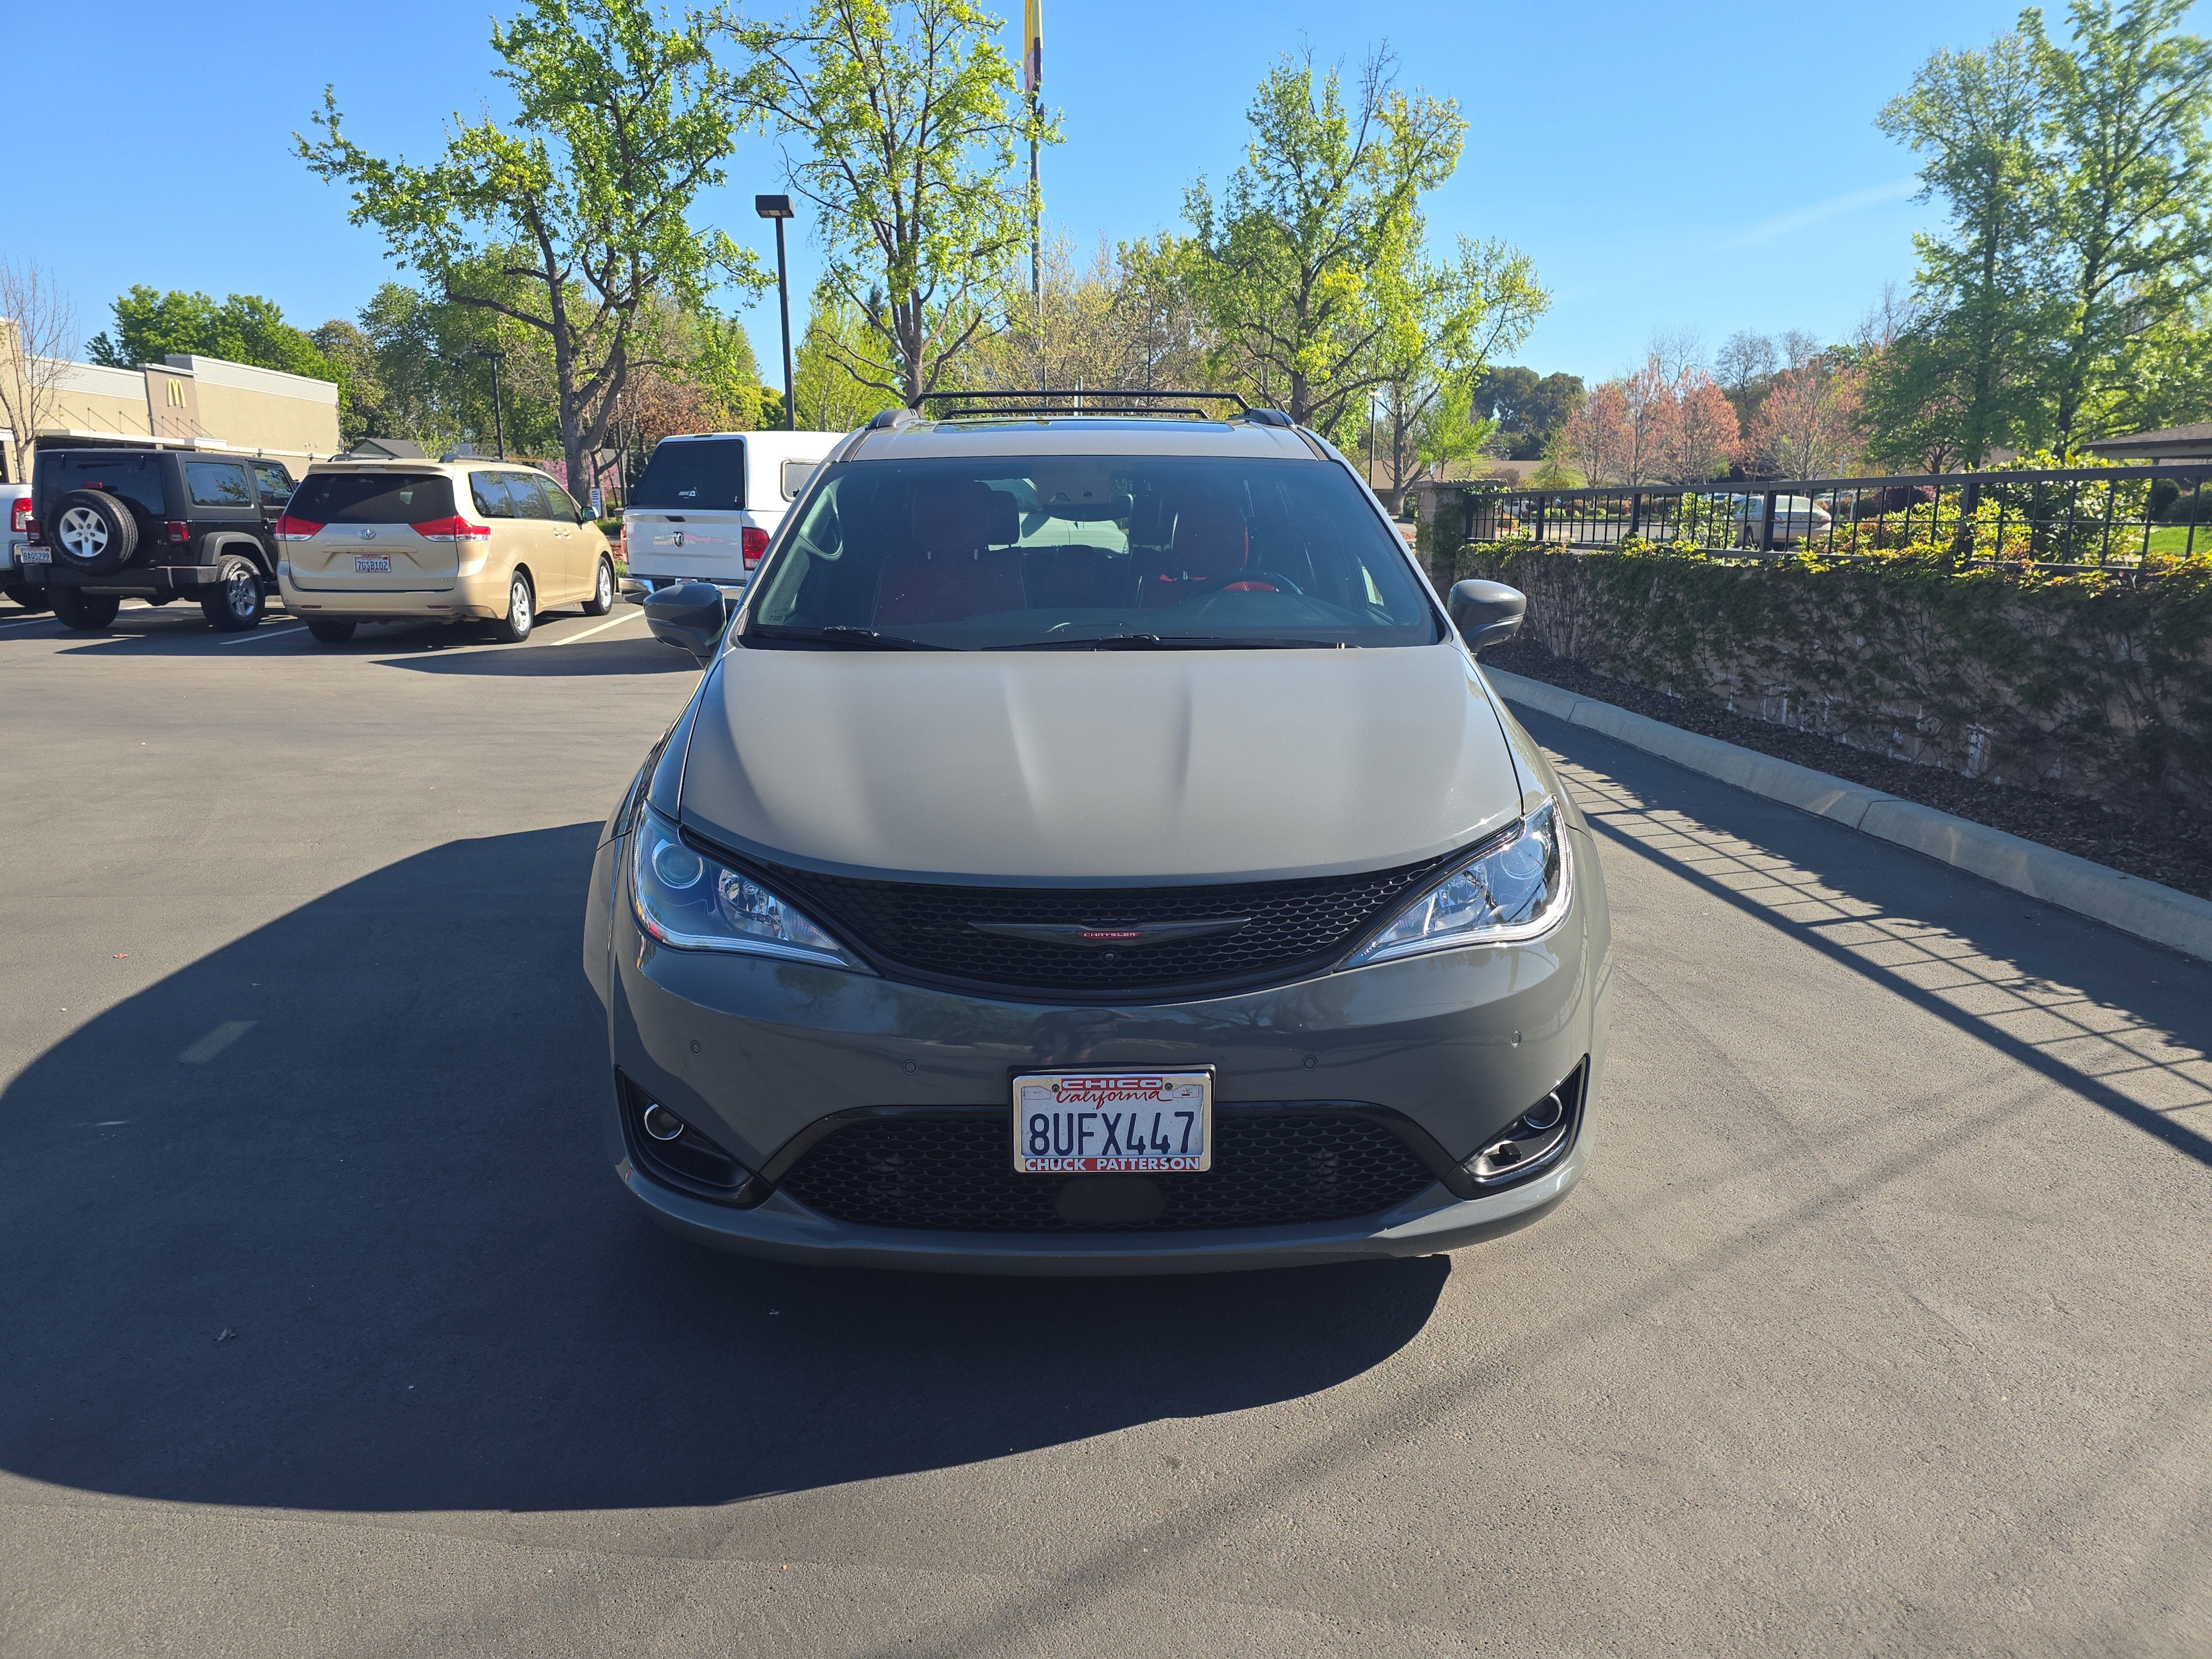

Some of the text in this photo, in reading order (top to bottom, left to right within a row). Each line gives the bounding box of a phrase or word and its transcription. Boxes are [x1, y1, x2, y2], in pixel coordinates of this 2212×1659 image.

[357, 561, 388, 570] 7GSB102
[1062, 1079, 1162, 1089] CHICO
[1056, 1090, 1173, 1110] California
[1030, 1111, 1194, 1156] 8UFX447
[1025, 1158, 1199, 1171] CHUCK PATTERSON
